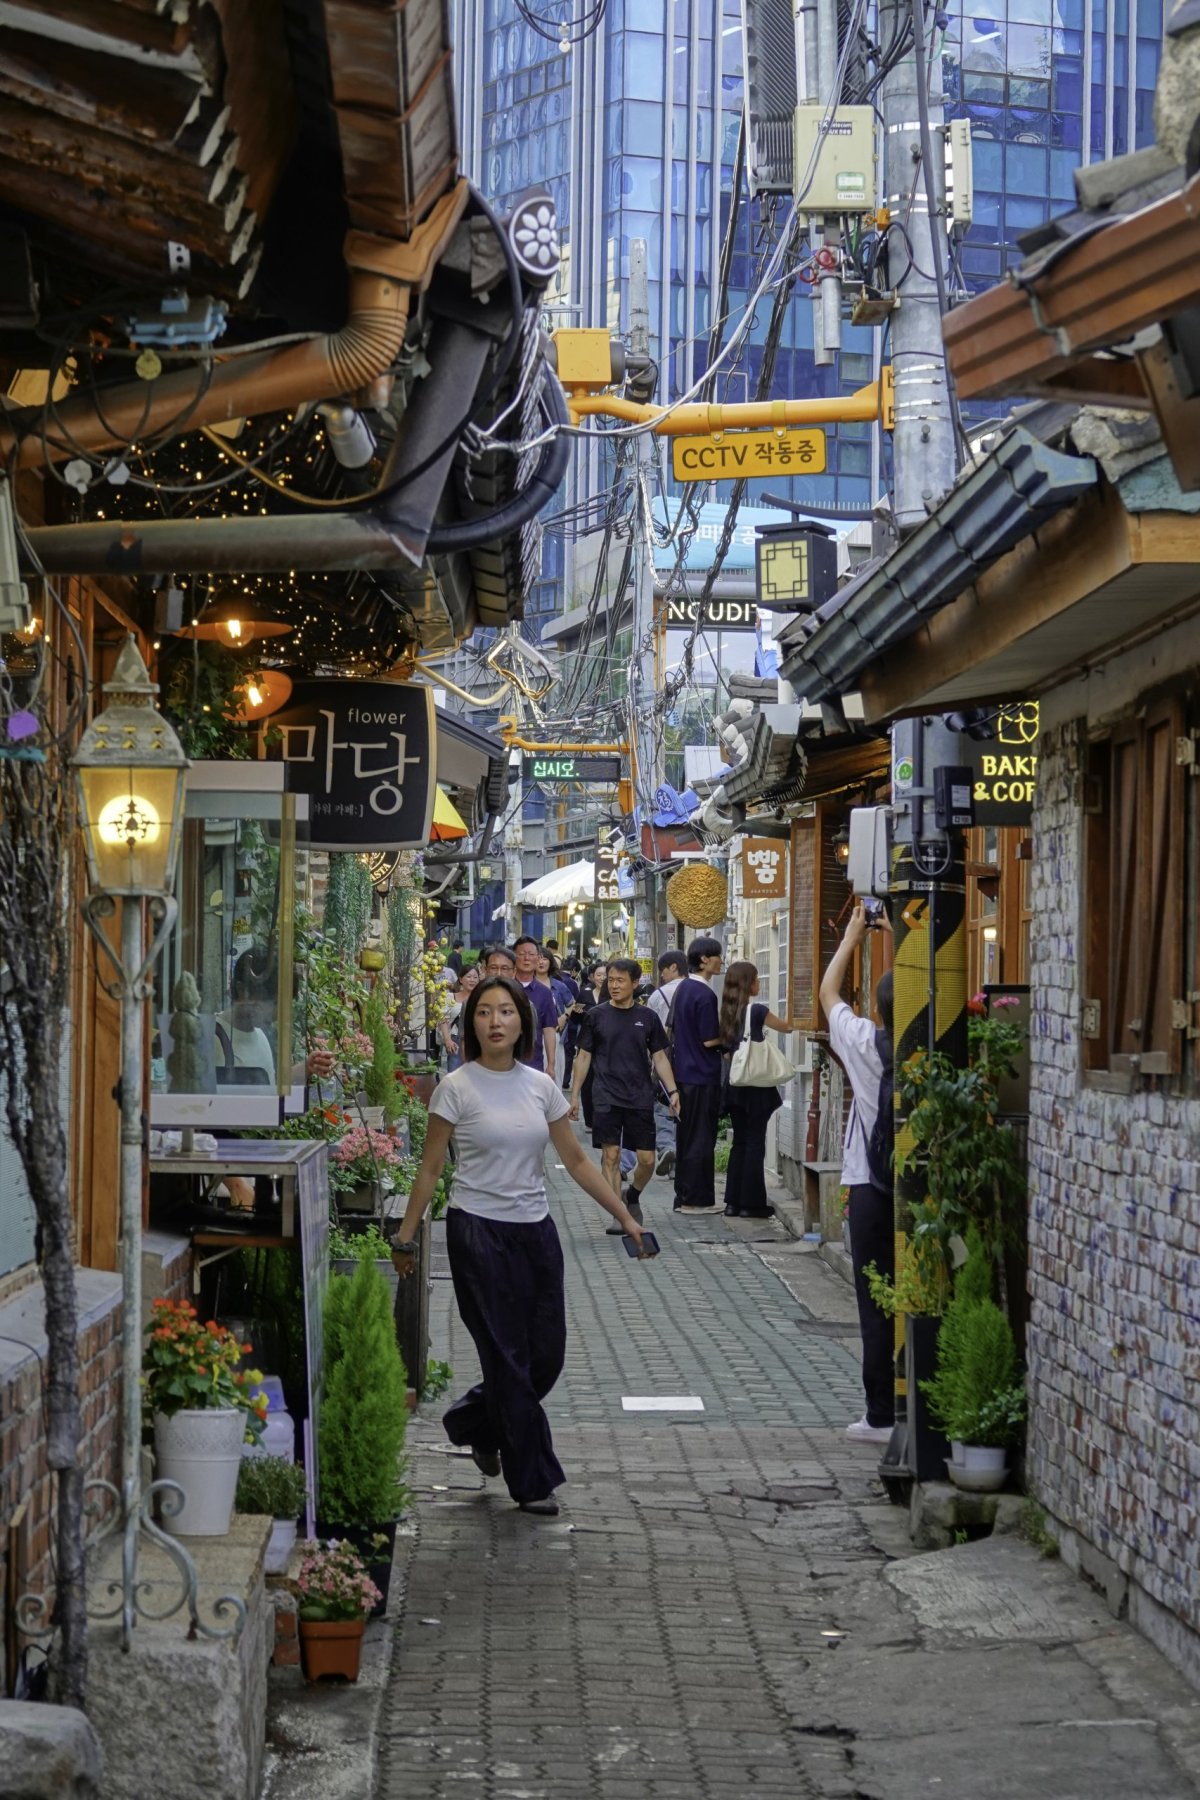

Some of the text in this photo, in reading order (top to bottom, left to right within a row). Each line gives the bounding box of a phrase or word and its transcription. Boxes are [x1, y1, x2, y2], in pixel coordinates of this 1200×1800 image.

[681, 439, 817, 469] CCTV 작동중
[347, 708, 407, 726] flower
[277, 708, 421, 816] 마당
[533, 761, 580, 778] 십시오.
